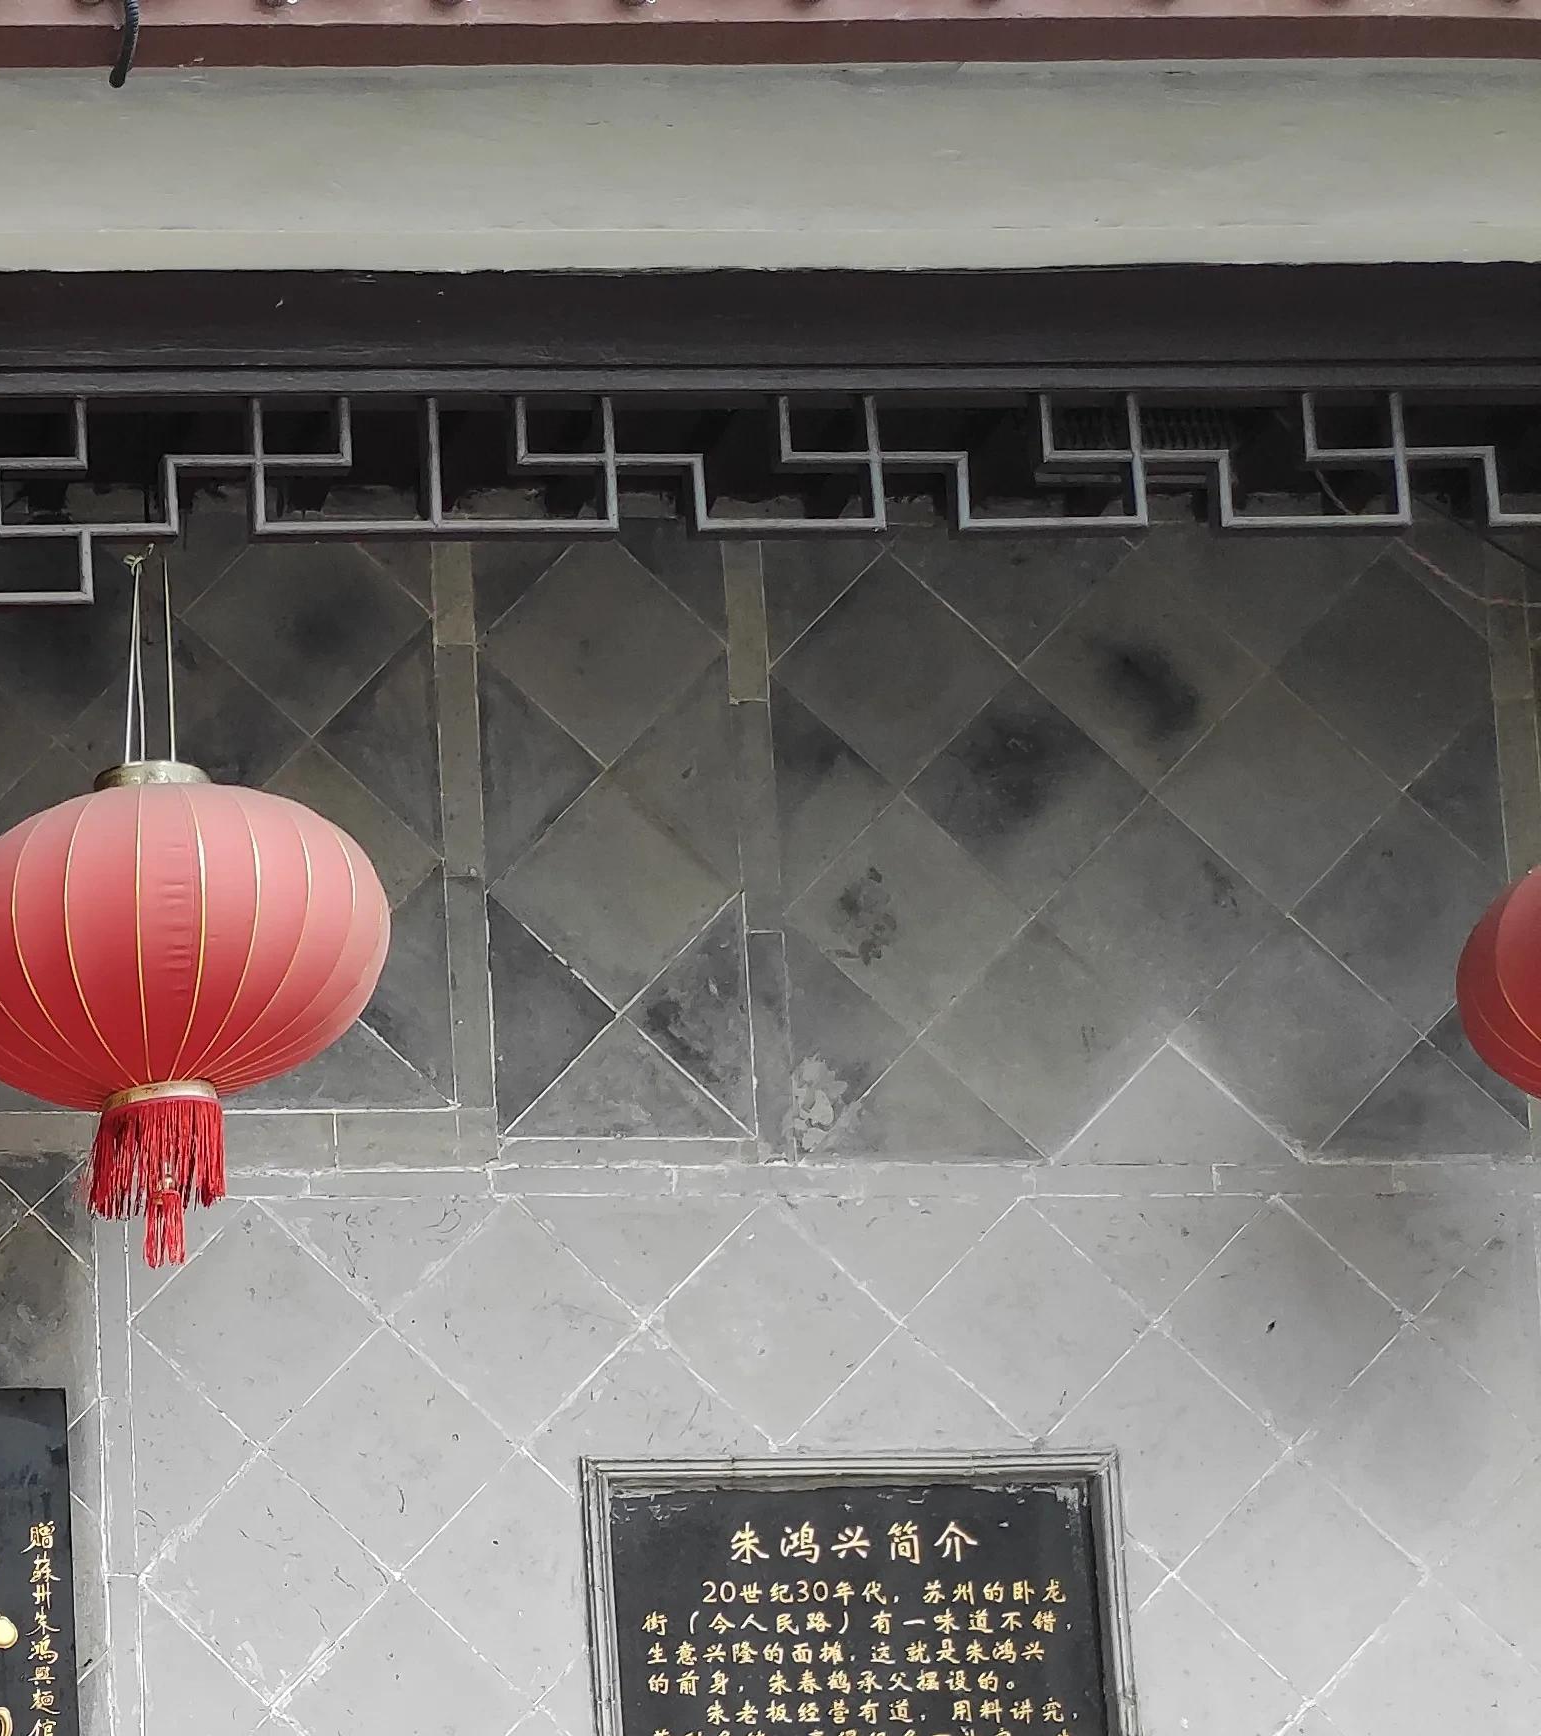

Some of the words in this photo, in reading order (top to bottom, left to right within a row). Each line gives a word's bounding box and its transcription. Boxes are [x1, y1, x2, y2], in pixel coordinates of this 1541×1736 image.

[730, 1520, 979, 1565] 朱鸿兴简介
